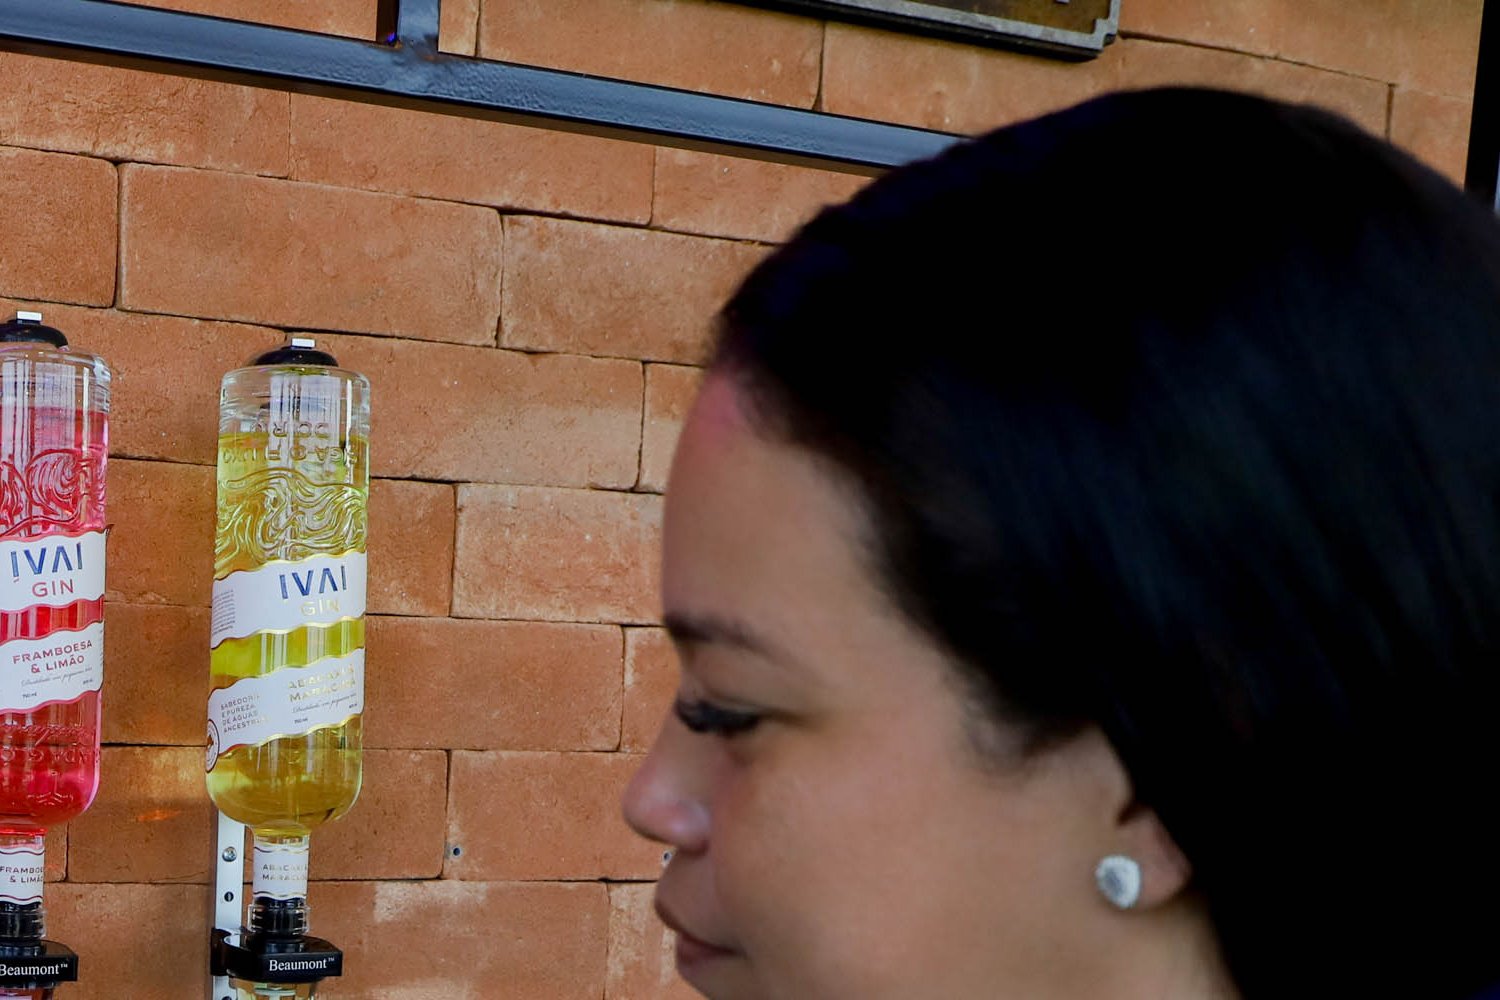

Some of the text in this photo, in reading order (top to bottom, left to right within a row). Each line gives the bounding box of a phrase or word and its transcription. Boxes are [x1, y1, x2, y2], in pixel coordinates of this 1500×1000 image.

[32, 579, 74, 598] GIN
[300, 599, 340, 617] GIN
[12, 640, 93, 664] FRAMBOESA
[30, 654, 85, 674] & LIMÃO
